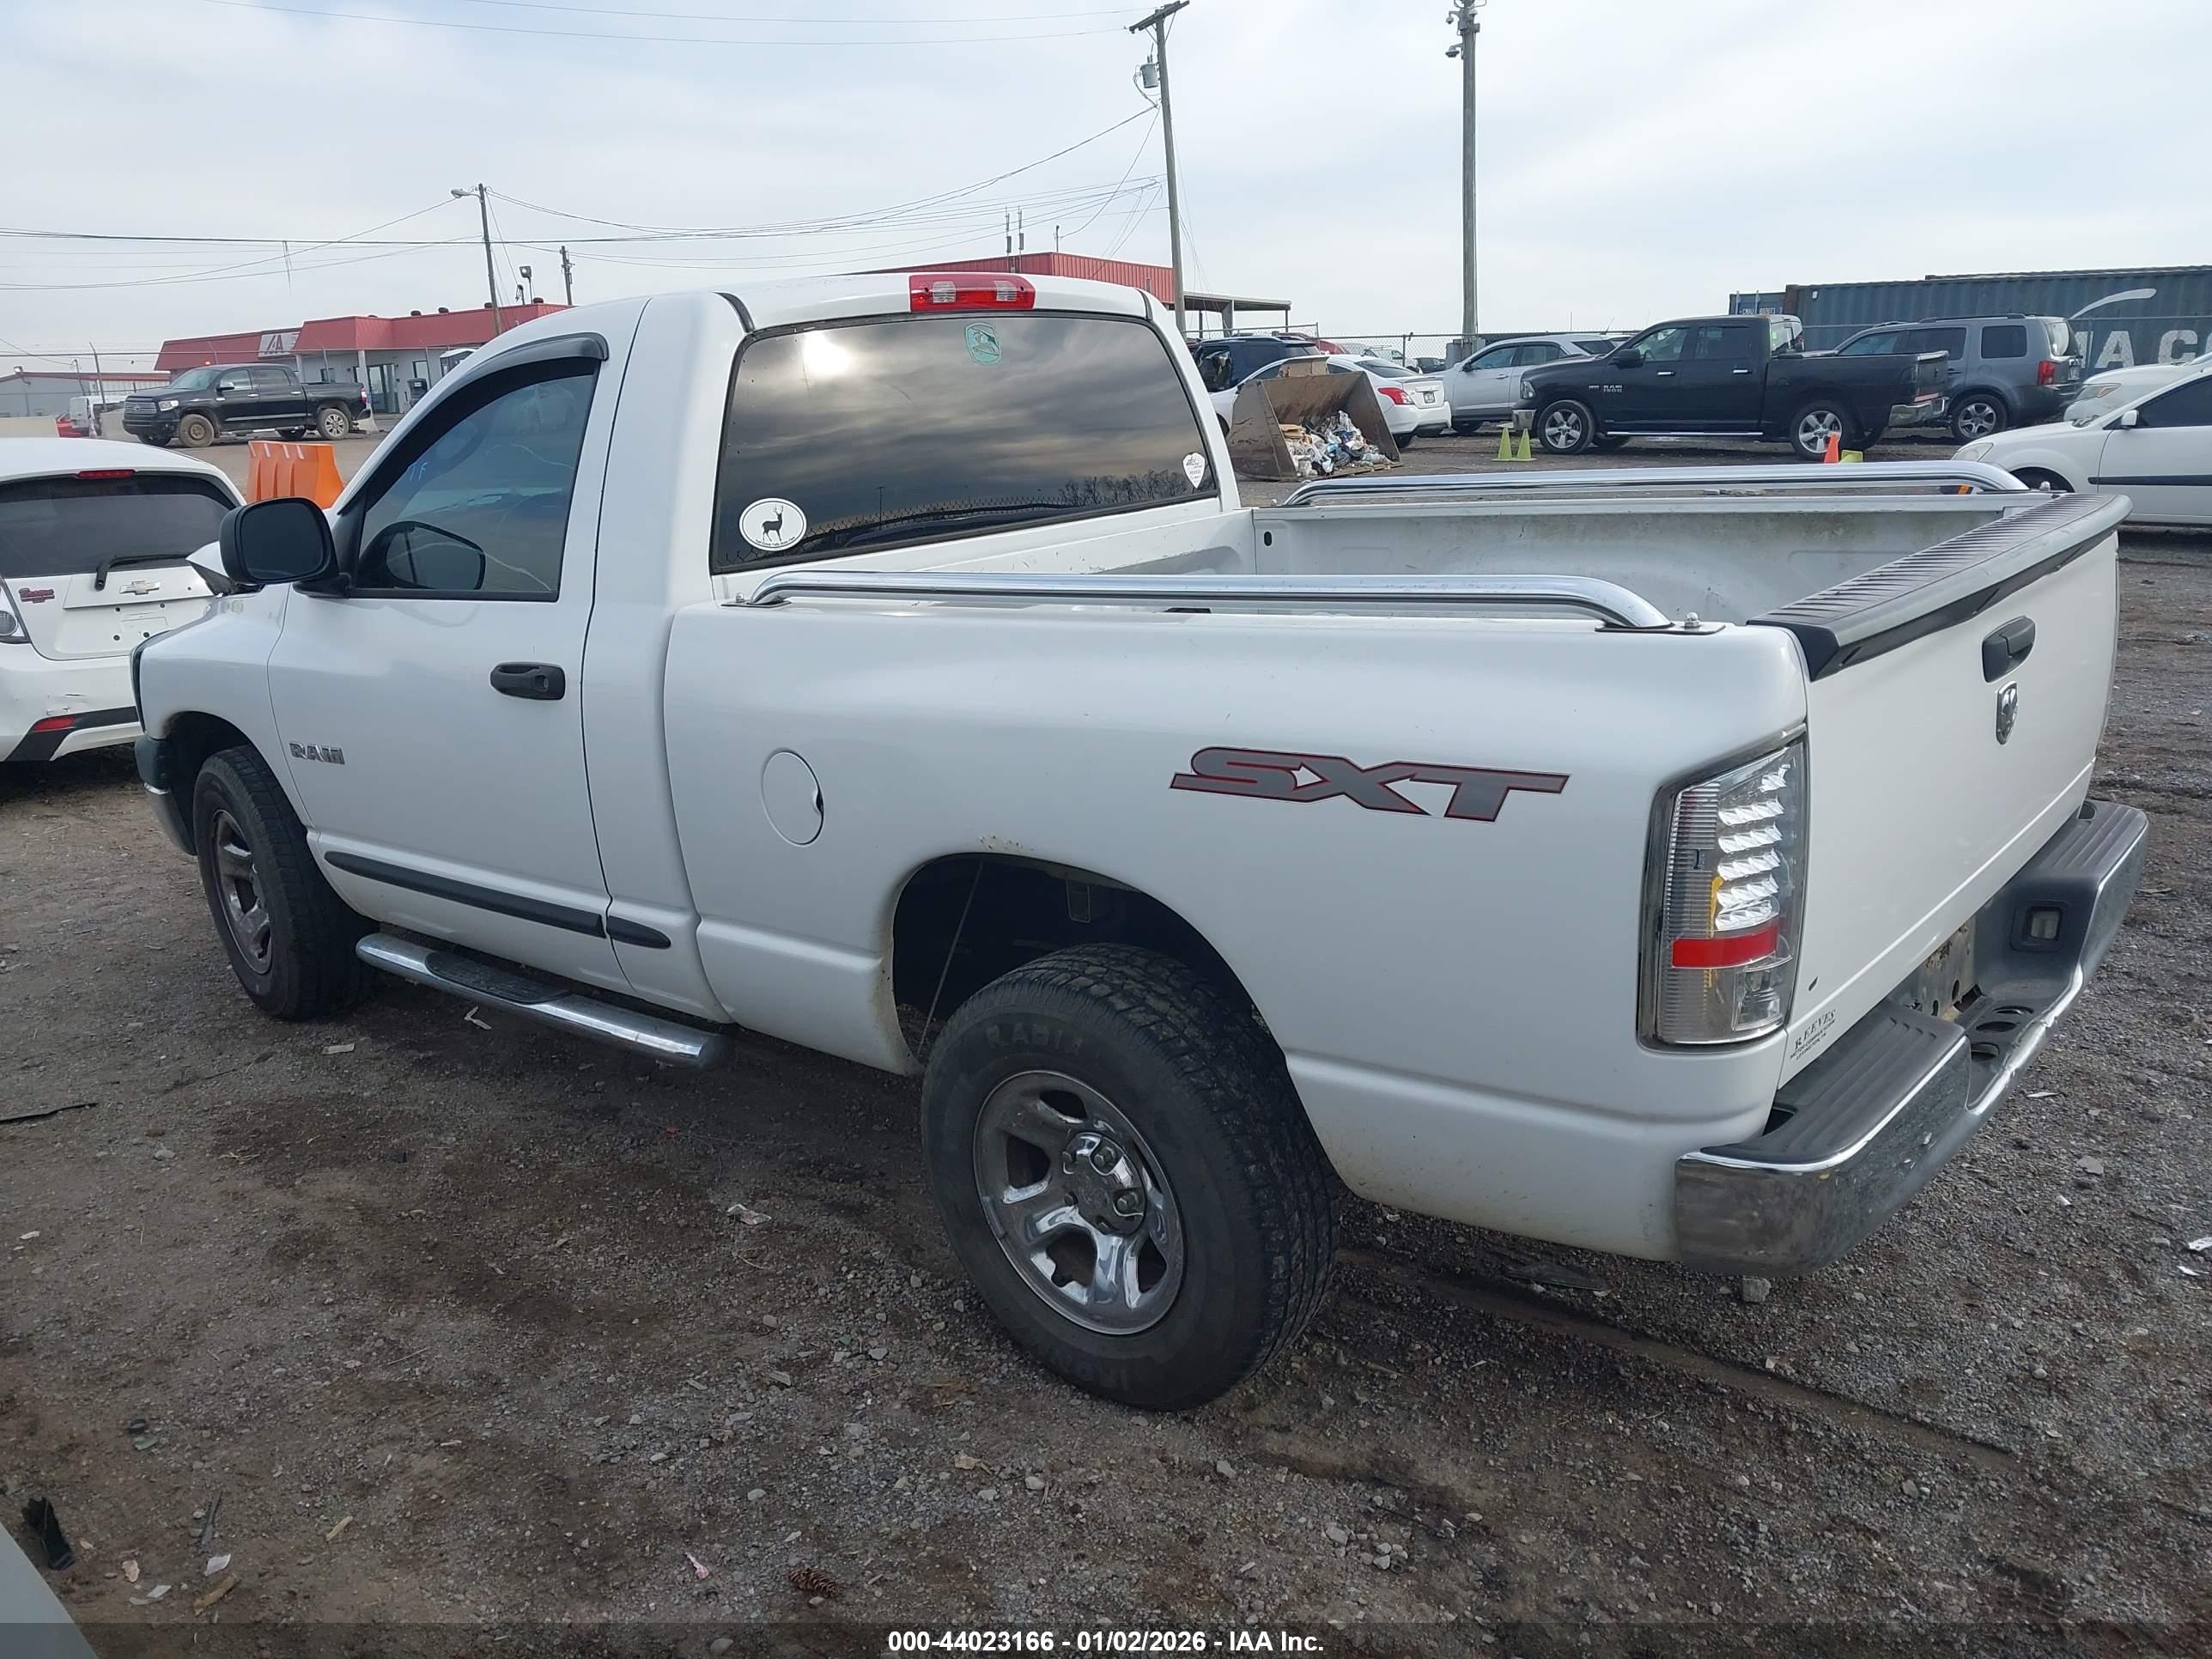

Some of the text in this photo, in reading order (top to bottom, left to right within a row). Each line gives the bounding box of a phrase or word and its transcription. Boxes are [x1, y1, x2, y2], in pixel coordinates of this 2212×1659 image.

[2158, 330, 2212, 366] C
[289, 742, 345, 765] RAM
[1170, 746, 1571, 822] SXT
[1796, 1009, 1836, 1050] REEVES
